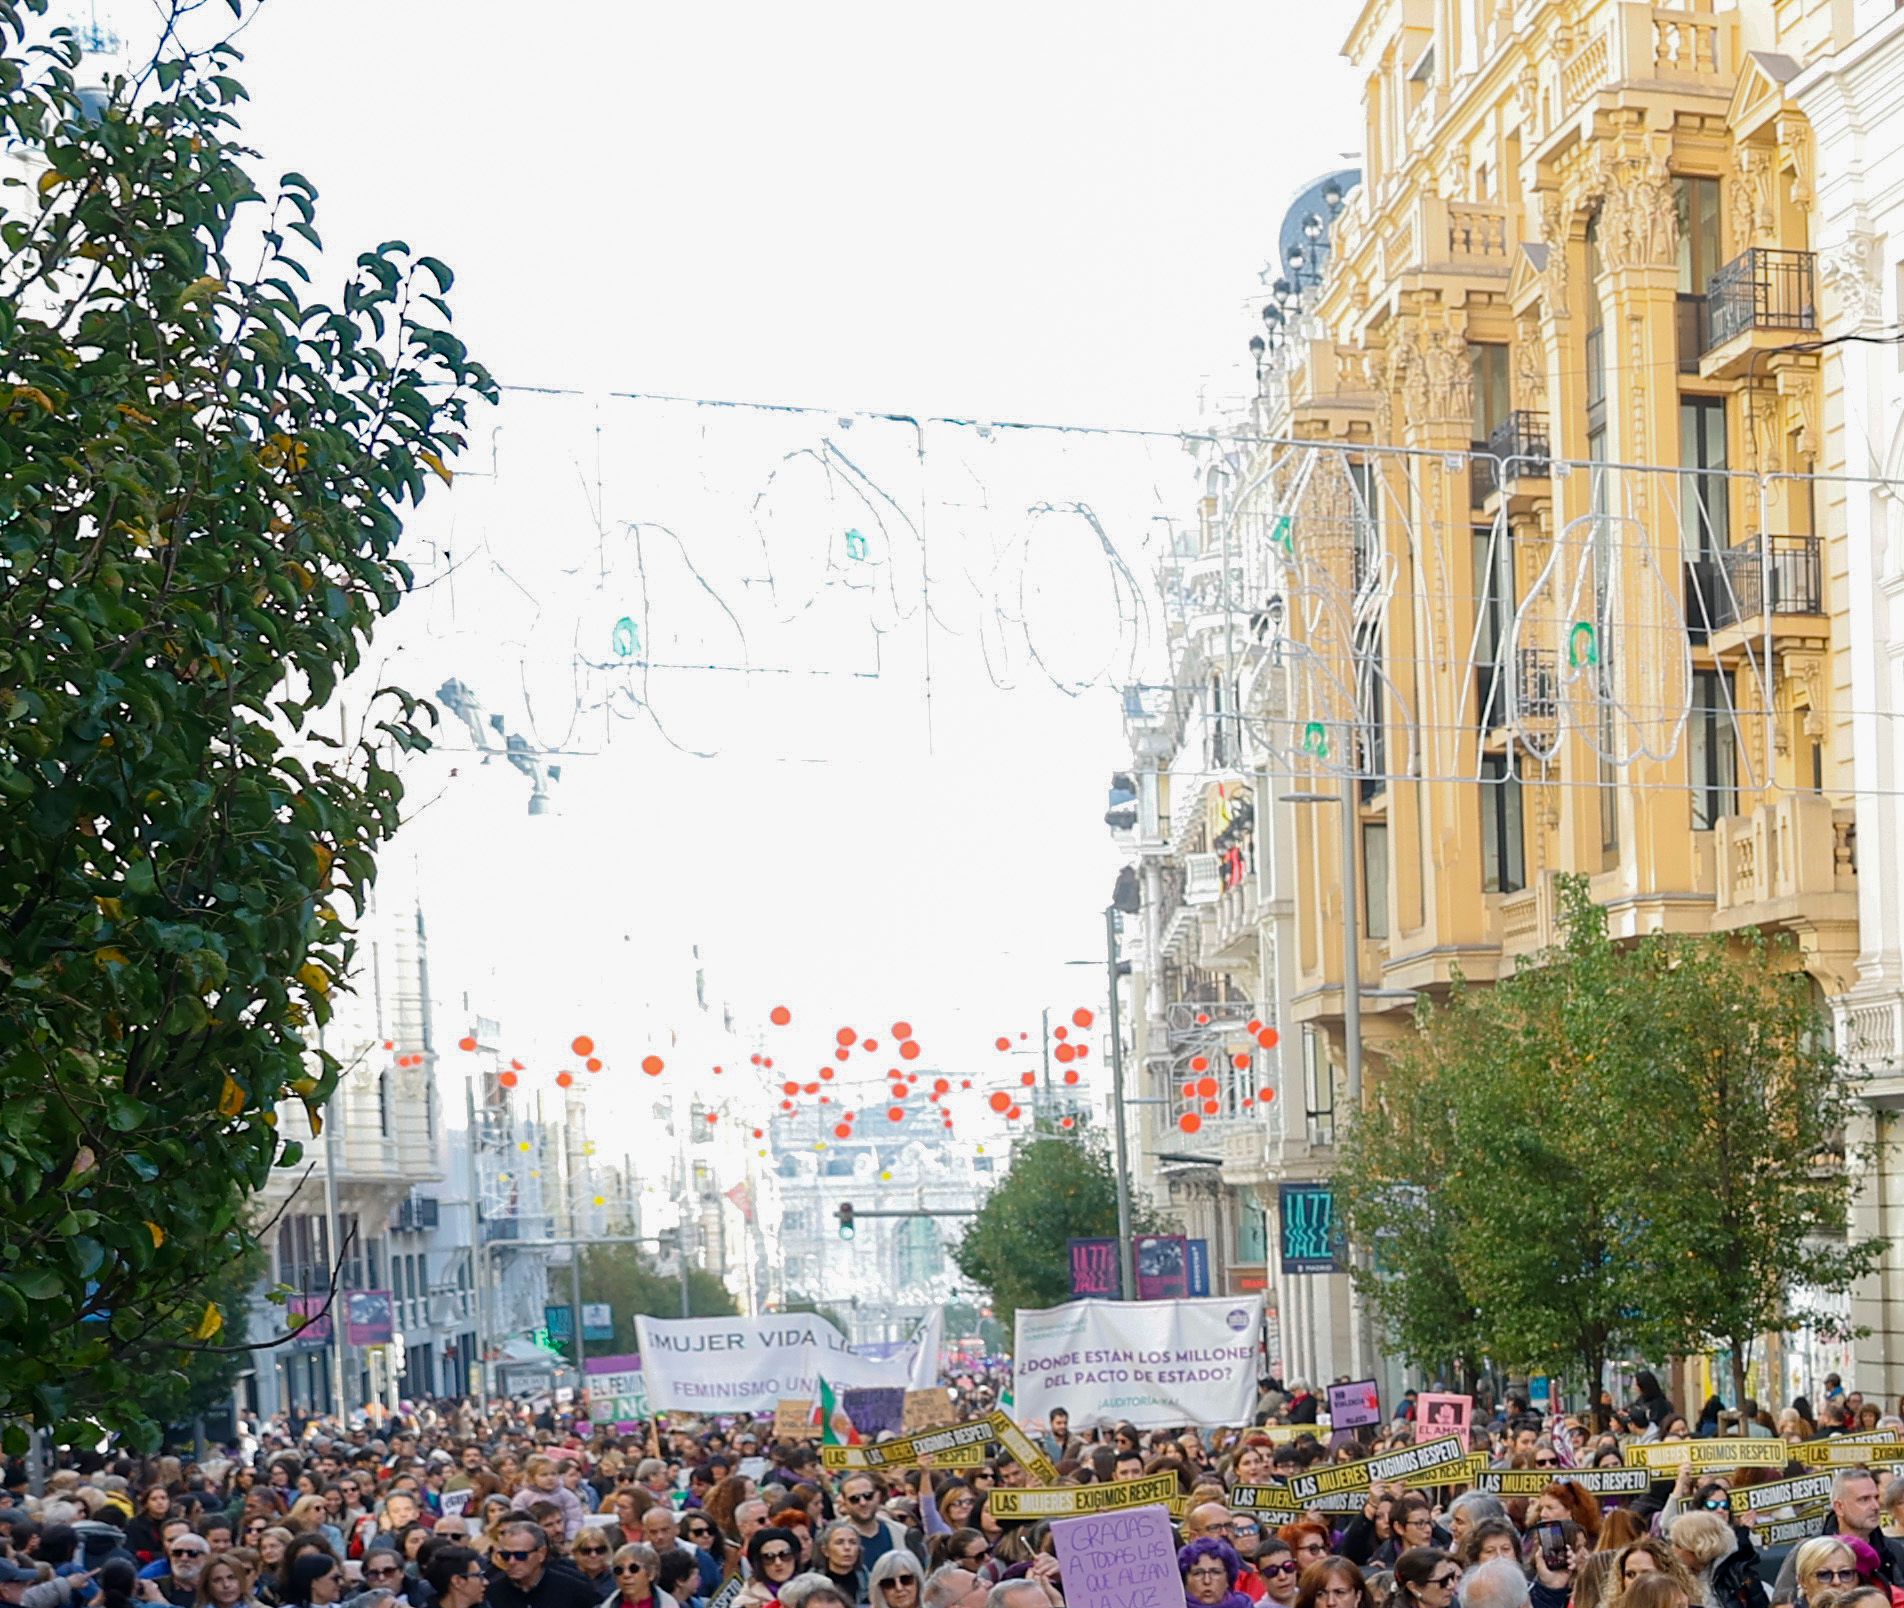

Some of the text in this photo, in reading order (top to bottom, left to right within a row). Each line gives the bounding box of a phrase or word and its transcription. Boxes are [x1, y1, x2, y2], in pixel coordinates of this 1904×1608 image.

[758, 1330, 818, 1348] VIDA
[1139, 1350, 1171, 1364] LOS
[673, 1379, 780, 1398] FEMINISMO
[1045, 1368, 1233, 1390] DEL PACTO DE ESTADO?
[1419, 1425, 1467, 1436] EL AMOR
[829, 1450, 846, 1465] LAS
[1631, 1451, 1647, 1466] LAS
[1690, 1444, 1739, 1462] EXIGIMOS
[1740, 1443, 1781, 1460] RESPETO
[1812, 1447, 1828, 1461] LAS
[1294, 1478, 1317, 1499] LAS
[1318, 1465, 1368, 1493] MUJERES
[1368, 1451, 1419, 1481] EXIGIMOS
[1419, 1439, 1460, 1467] RESPETO
[1479, 1474, 1500, 1492] LAS
[1502, 1473, 1551, 1492] MUJERES
[1602, 1471, 1647, 1491] RESPETO
[1749, 1484, 1792, 1508] EXIGIMOS
[1792, 1475, 1832, 1501] RESPETO
[996, 1495, 1018, 1512] LAS
[1076, 1486, 1128, 1509] EXIGIMOS
[1129, 1479, 1171, 1501] RESPETO
[1234, 1488, 1255, 1506] LAS
[1256, 1489, 1291, 1506] MUJER
[1071, 1515, 1154, 1551] GRACIAS
[1069, 1541, 1167, 1575] A TODAS LAS
[1086, 1563, 1170, 1592] QUE ALZAN
